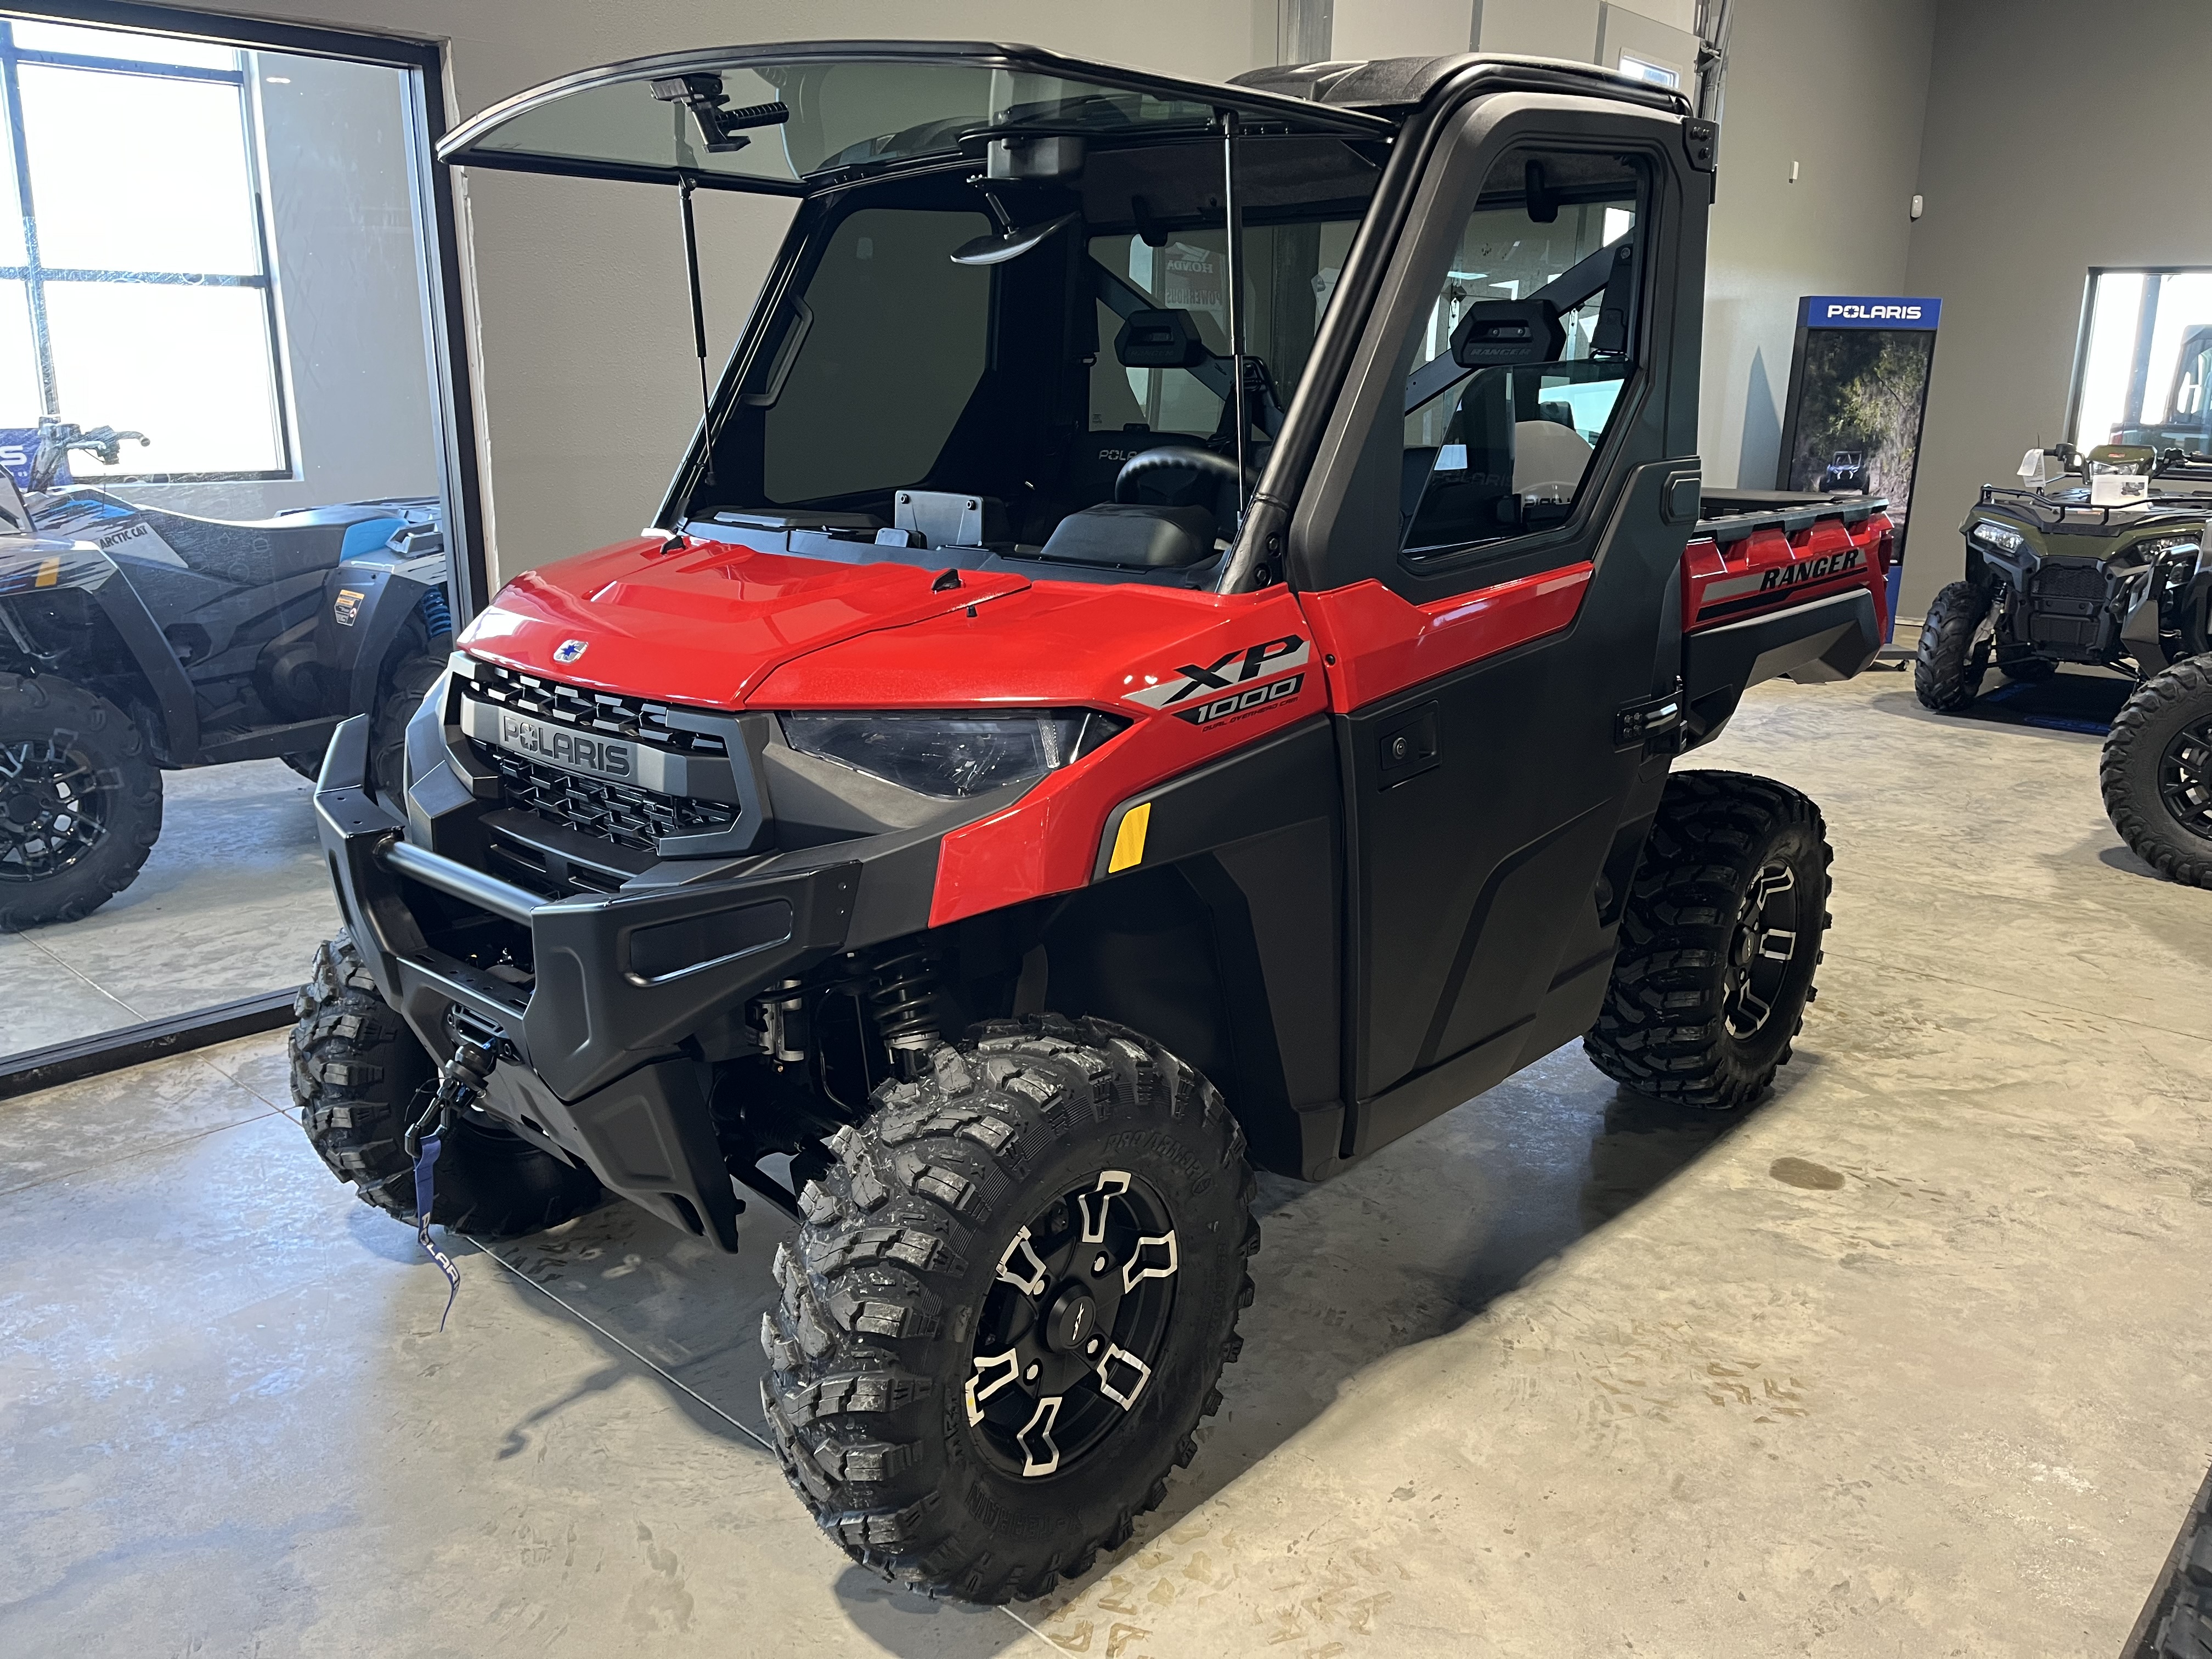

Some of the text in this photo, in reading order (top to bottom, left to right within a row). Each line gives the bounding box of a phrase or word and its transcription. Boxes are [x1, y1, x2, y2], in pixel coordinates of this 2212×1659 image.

[1827, 304, 1922, 320] POLARIS
[1470, 348, 1532, 356] RANGER
[1098, 449, 1138, 461] POLA
[99, 525, 148, 550] ARCTIC CAT
[1759, 549, 1859, 592] RANGER
[1160, 634, 1305, 707] XP
[1197, 677, 1297, 723] 1000
[1202, 696, 1299, 732] DUAL OVERHEAD CAM
[504, 715, 630, 776] POLARIS
[419, 1211, 460, 1296] POLARI
